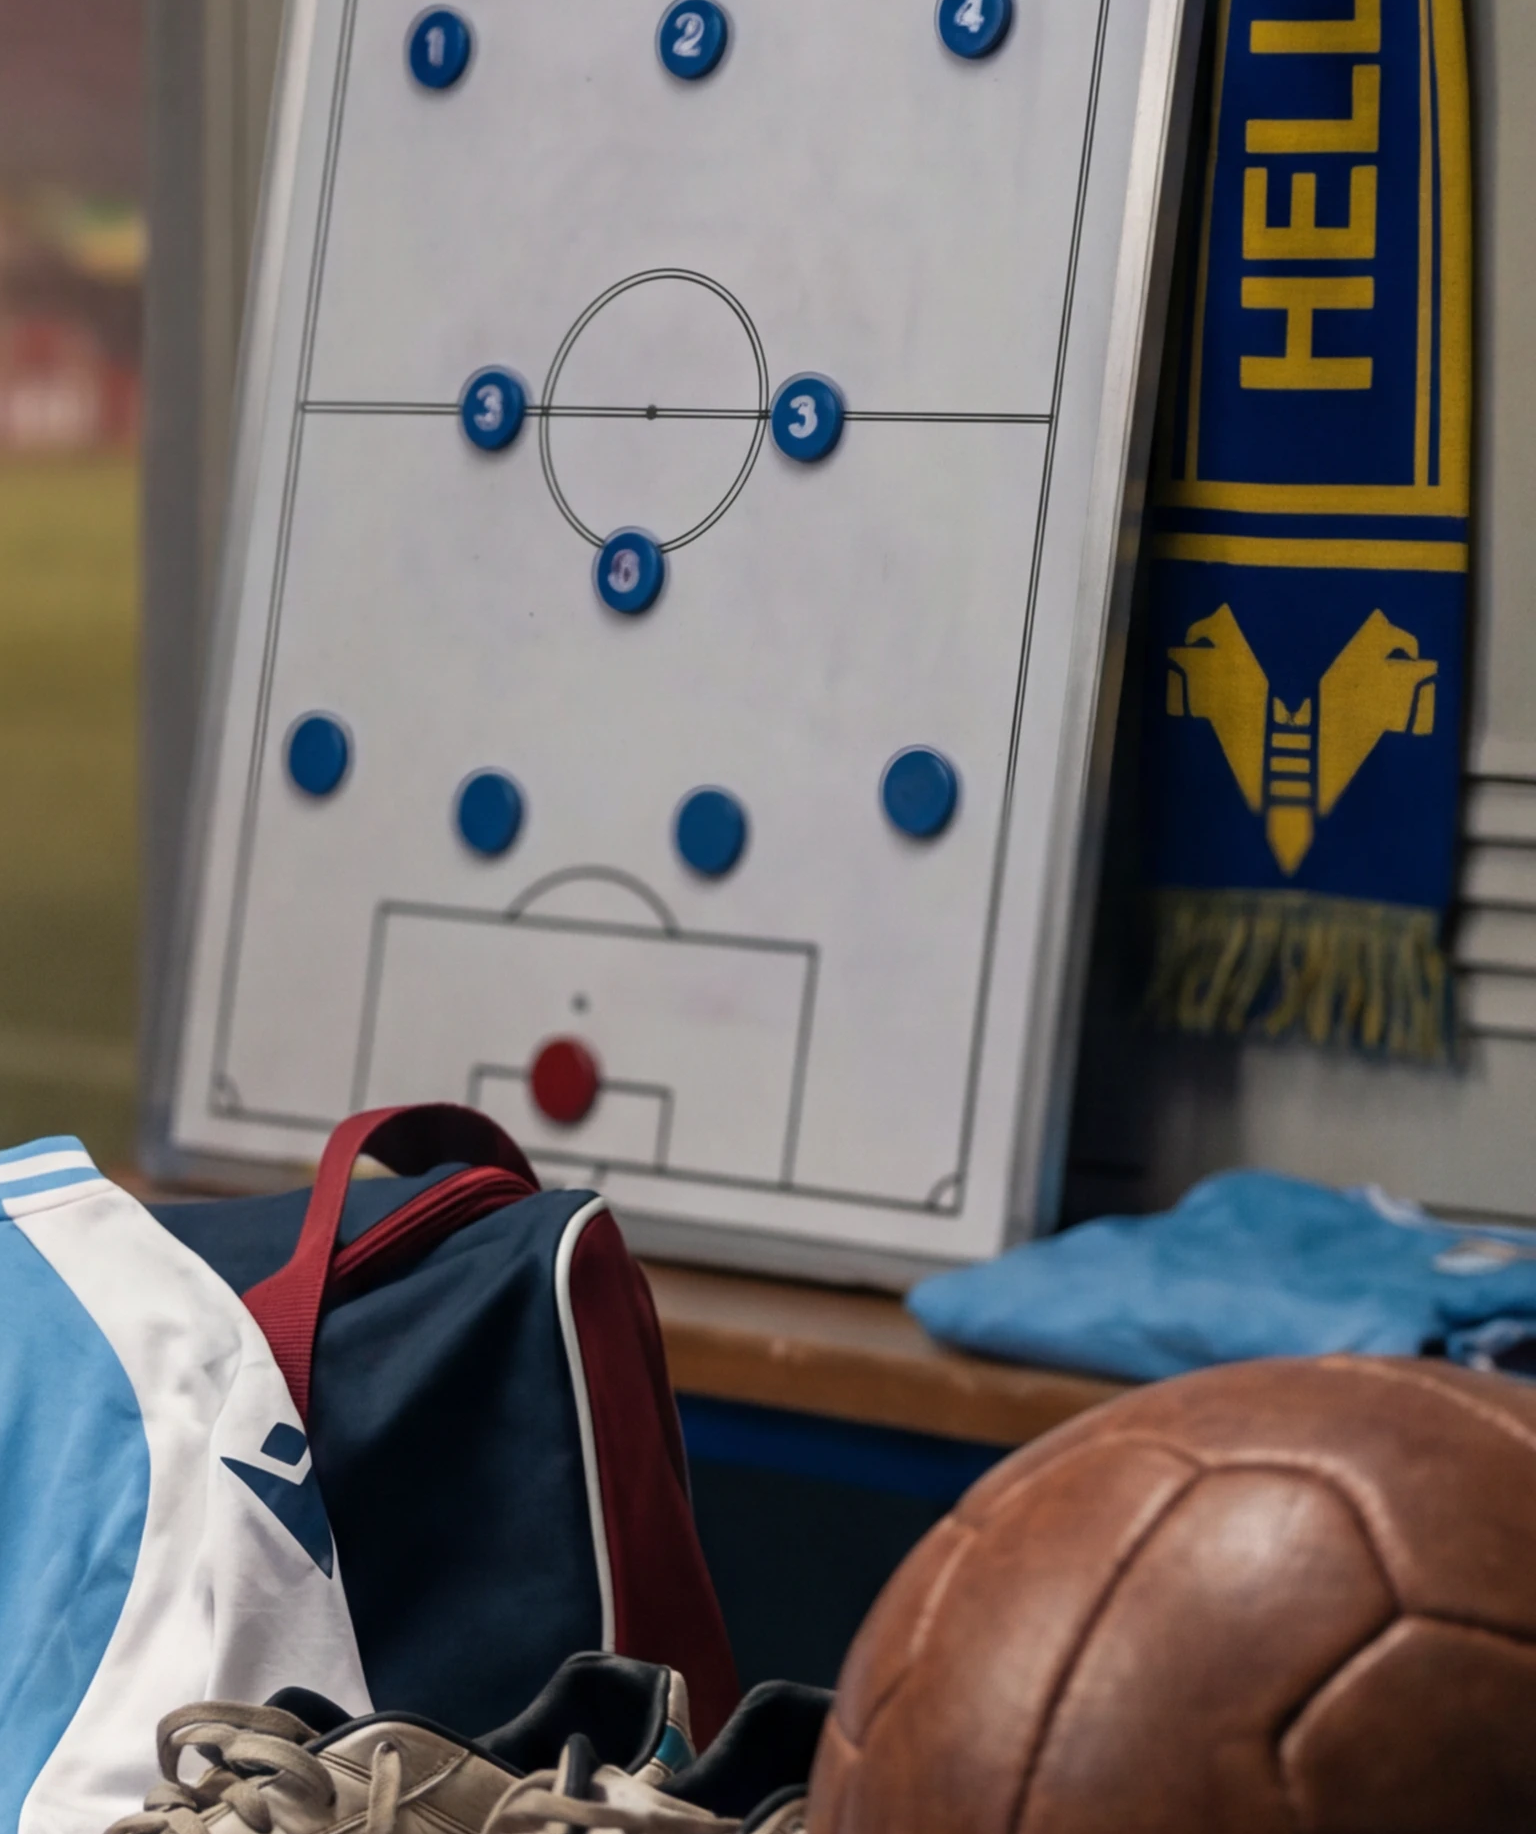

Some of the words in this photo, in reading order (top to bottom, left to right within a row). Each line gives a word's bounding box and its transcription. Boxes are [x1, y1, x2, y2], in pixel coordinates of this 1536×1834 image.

[425, 26, 446, 67] 1
[672, 12, 705, 57] 2
[474, 384, 504, 431] 3
[787, 394, 818, 439] 3
